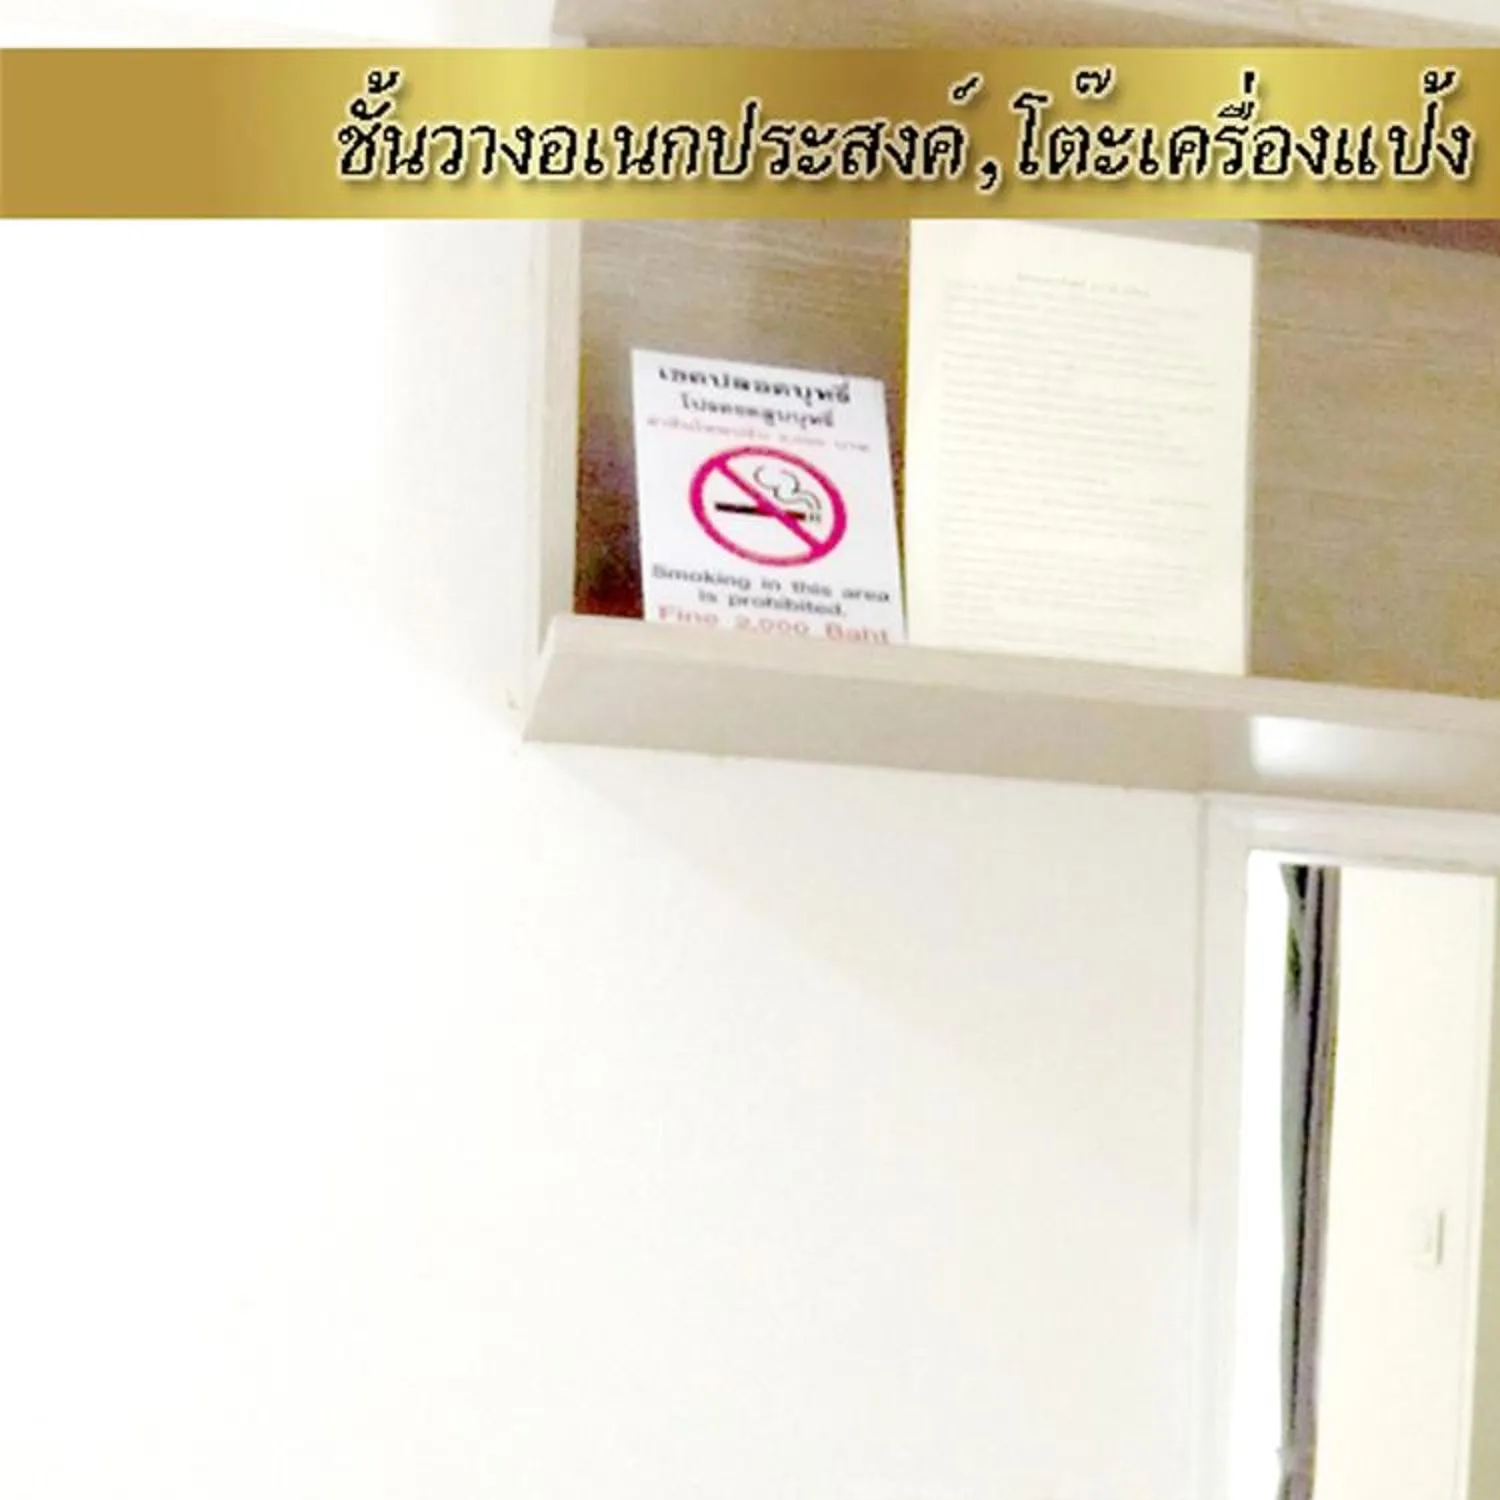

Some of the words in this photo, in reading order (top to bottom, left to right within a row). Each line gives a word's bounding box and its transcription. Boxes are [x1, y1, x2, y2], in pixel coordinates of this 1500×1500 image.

[651, 563, 752, 591] Smoking
[760, 578, 781, 592] in
[791, 579, 832, 598] this
[841, 588, 890, 604] area
[697, 587, 718, 604] is
[657, 603, 719, 626] Fine
